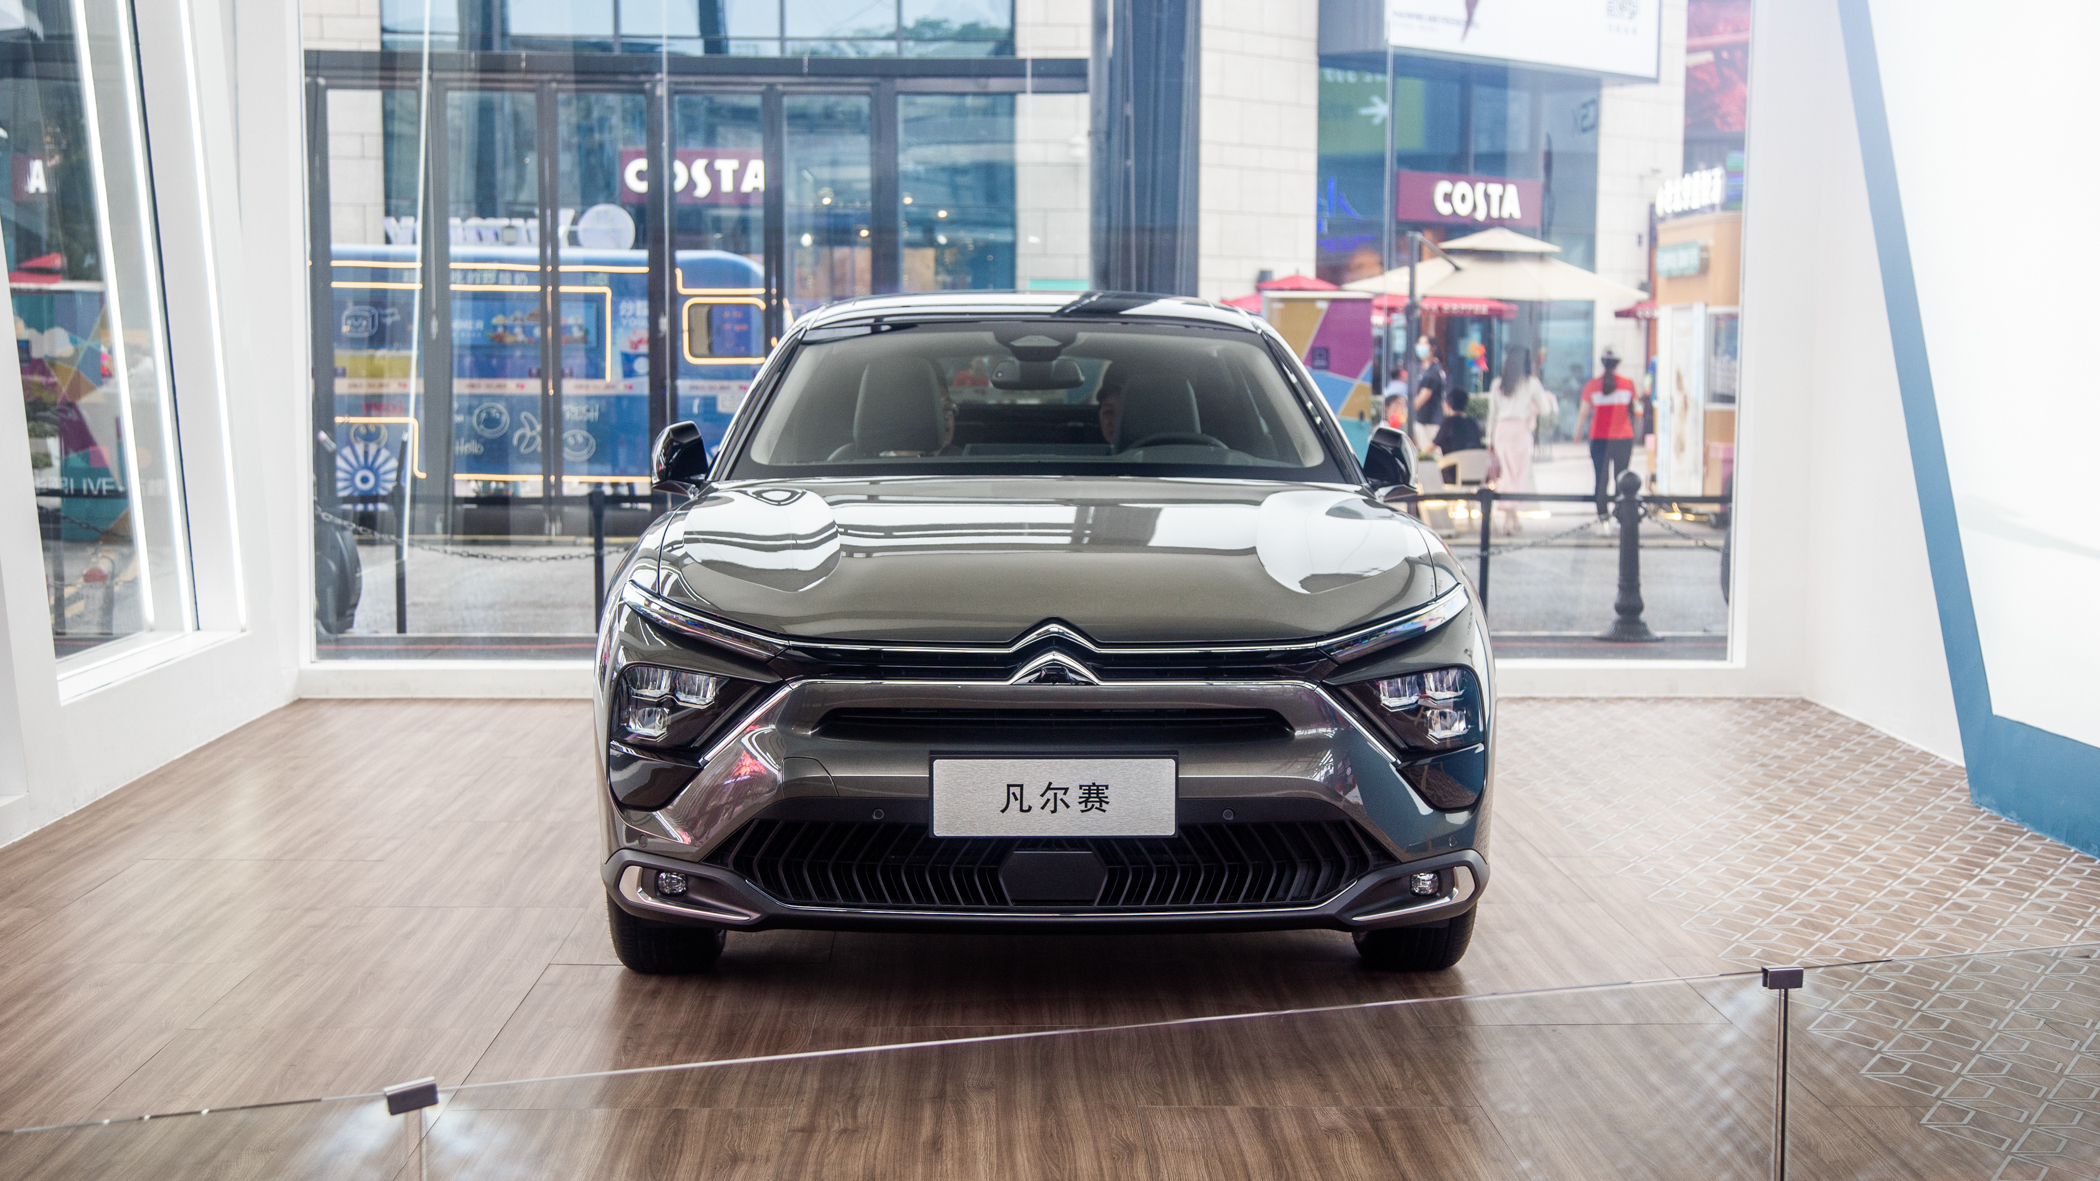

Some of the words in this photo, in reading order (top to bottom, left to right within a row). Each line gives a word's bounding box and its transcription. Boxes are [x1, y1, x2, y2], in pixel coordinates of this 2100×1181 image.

[1433, 179, 1522, 222] COSTA
[999, 781, 1110, 815] 凡尔赛
